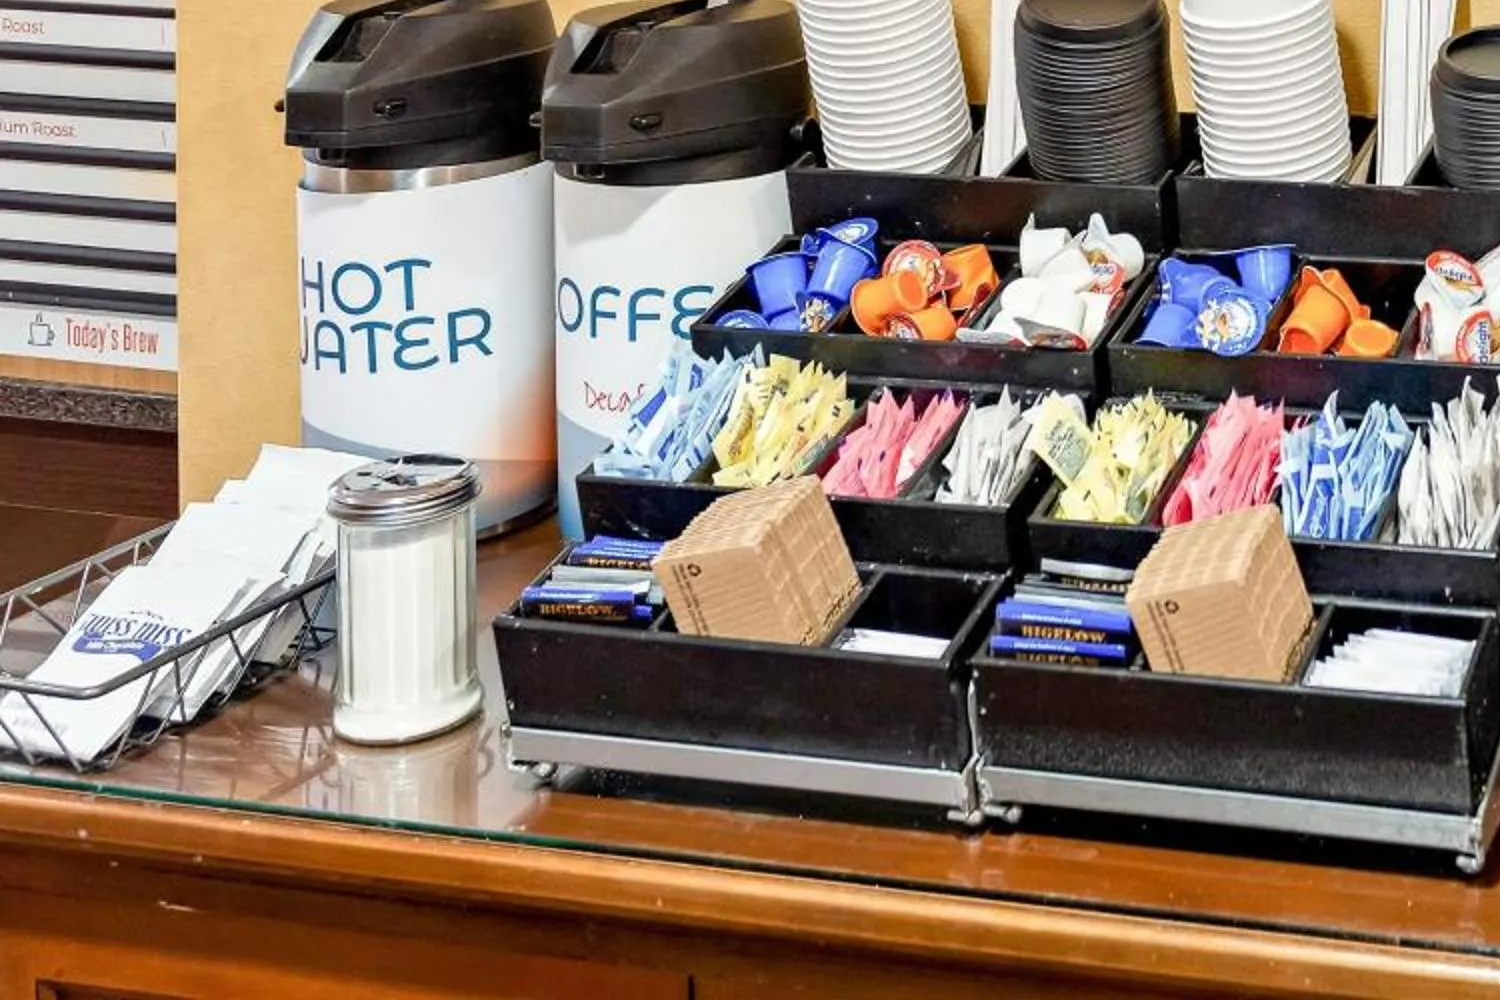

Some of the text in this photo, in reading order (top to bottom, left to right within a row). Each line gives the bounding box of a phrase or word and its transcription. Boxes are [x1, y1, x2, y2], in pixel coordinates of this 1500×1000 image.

[2, 17, 45, 35] Roast
[32, 121, 76, 138] Roast
[301, 256, 432, 316] HOT
[65, 317, 159, 355] Today's Brew
